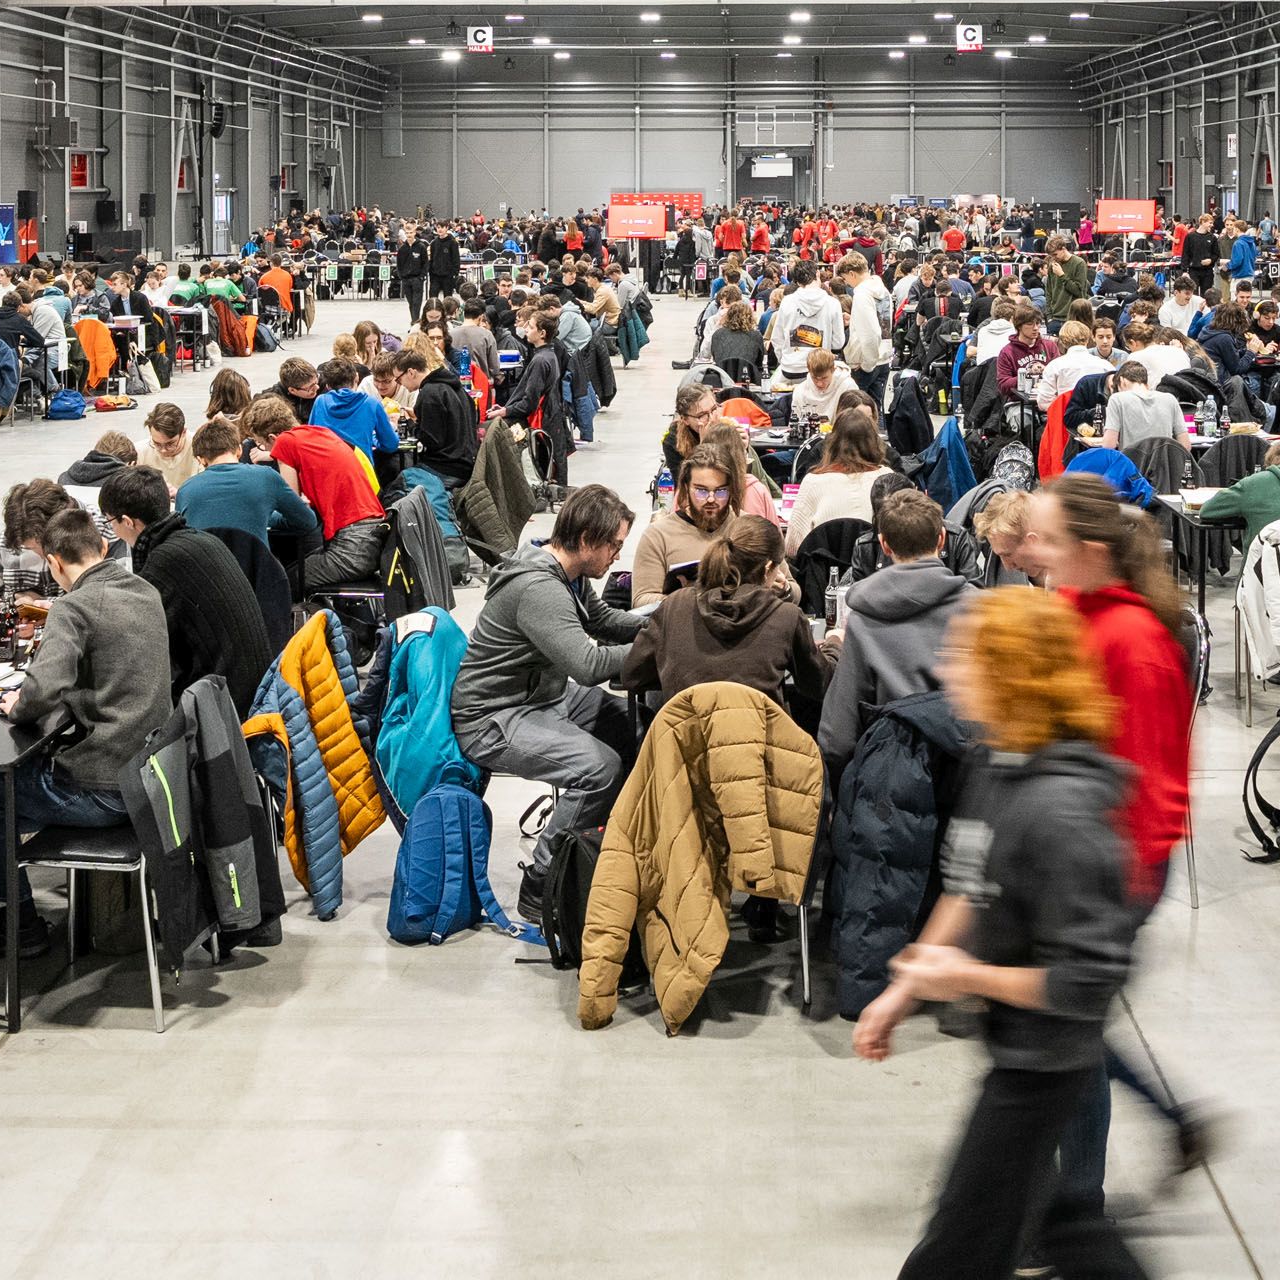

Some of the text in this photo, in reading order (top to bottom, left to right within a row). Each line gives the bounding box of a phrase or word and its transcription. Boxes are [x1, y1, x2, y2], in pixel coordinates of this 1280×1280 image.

[473, 29, 486, 43] C
[964, 28, 976, 41] C
[329, 268, 335, 277] E
[1272, 267, 1278, 275] D
